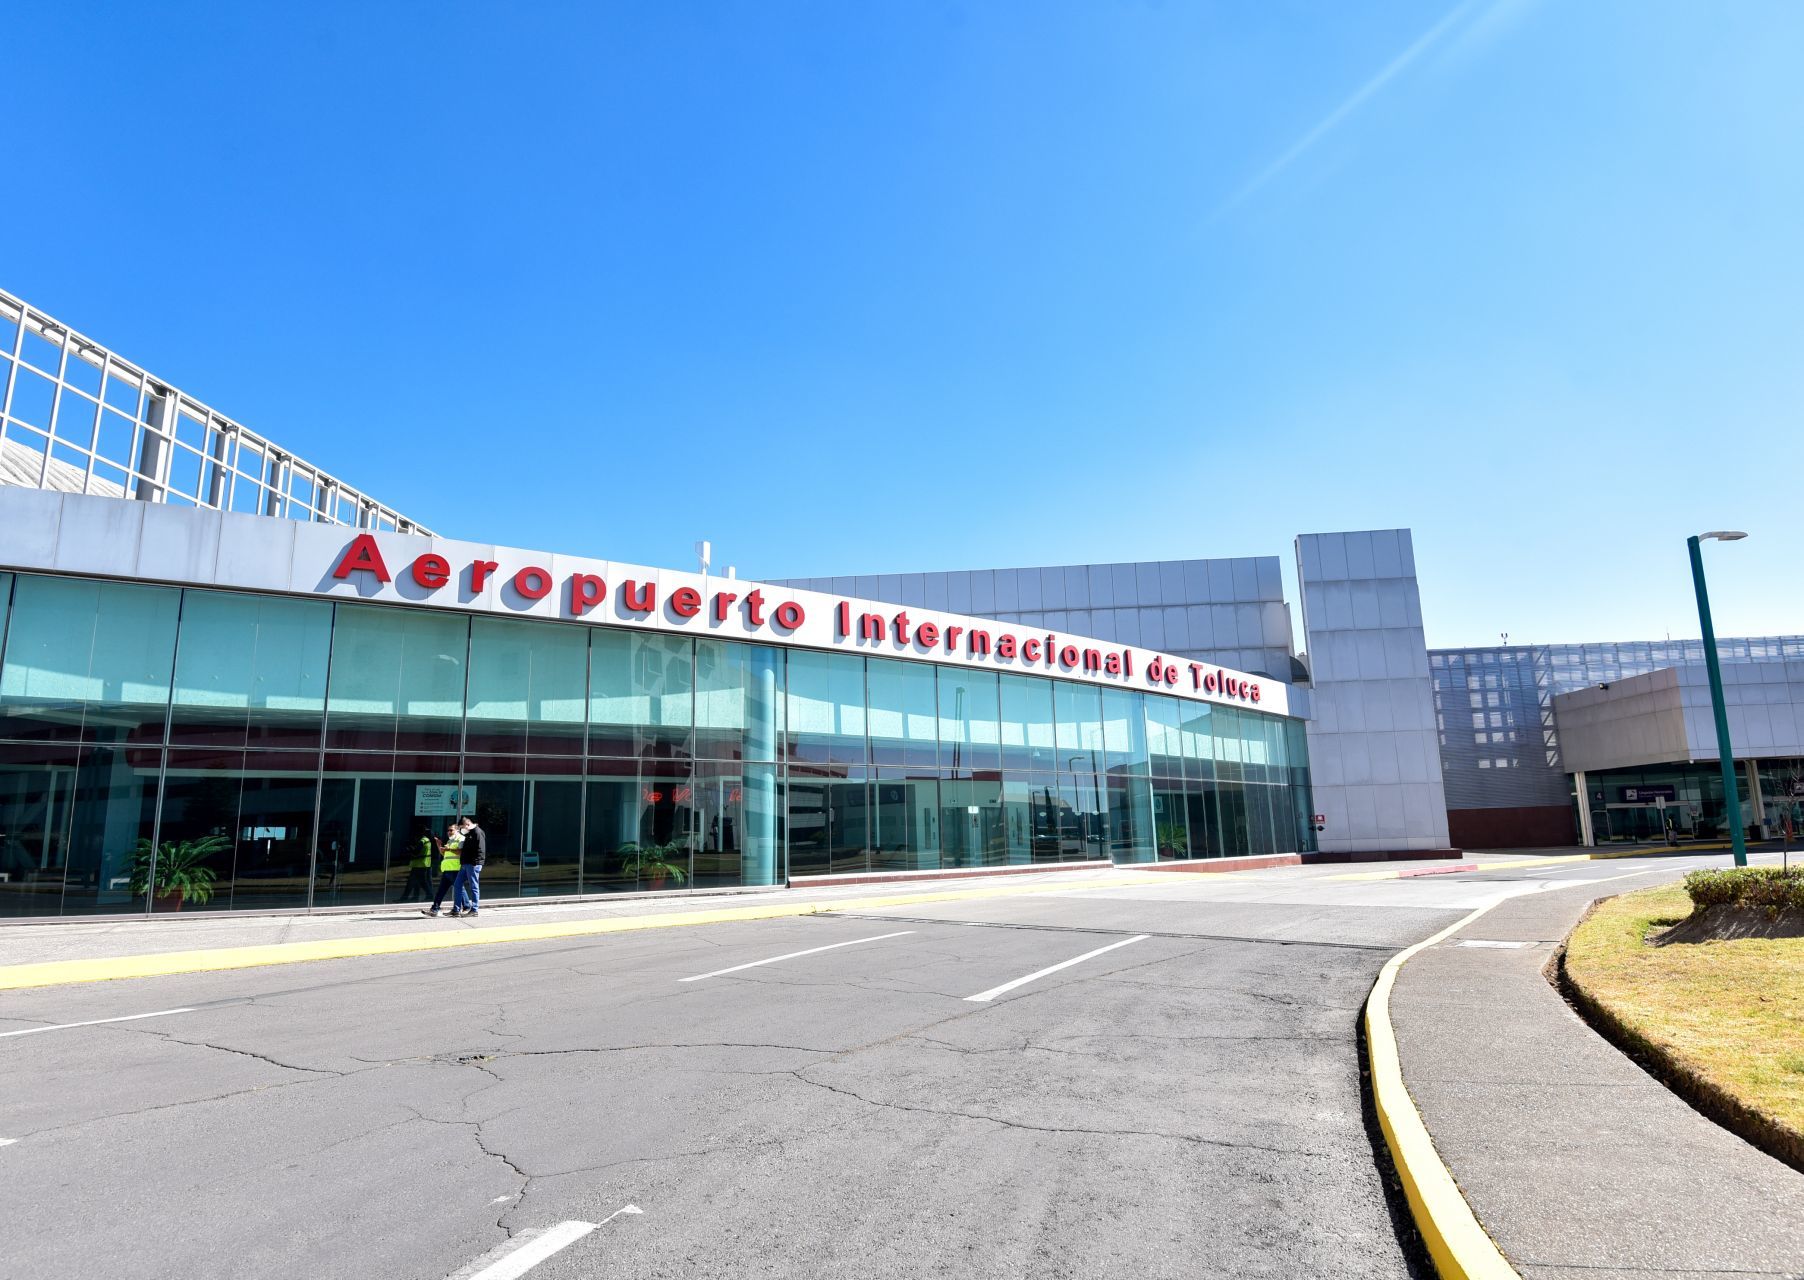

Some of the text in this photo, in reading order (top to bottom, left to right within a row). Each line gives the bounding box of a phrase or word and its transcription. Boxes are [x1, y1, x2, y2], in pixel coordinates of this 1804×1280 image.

[333, 533, 1261, 701] Aeropuerto Internacional de Toluca
